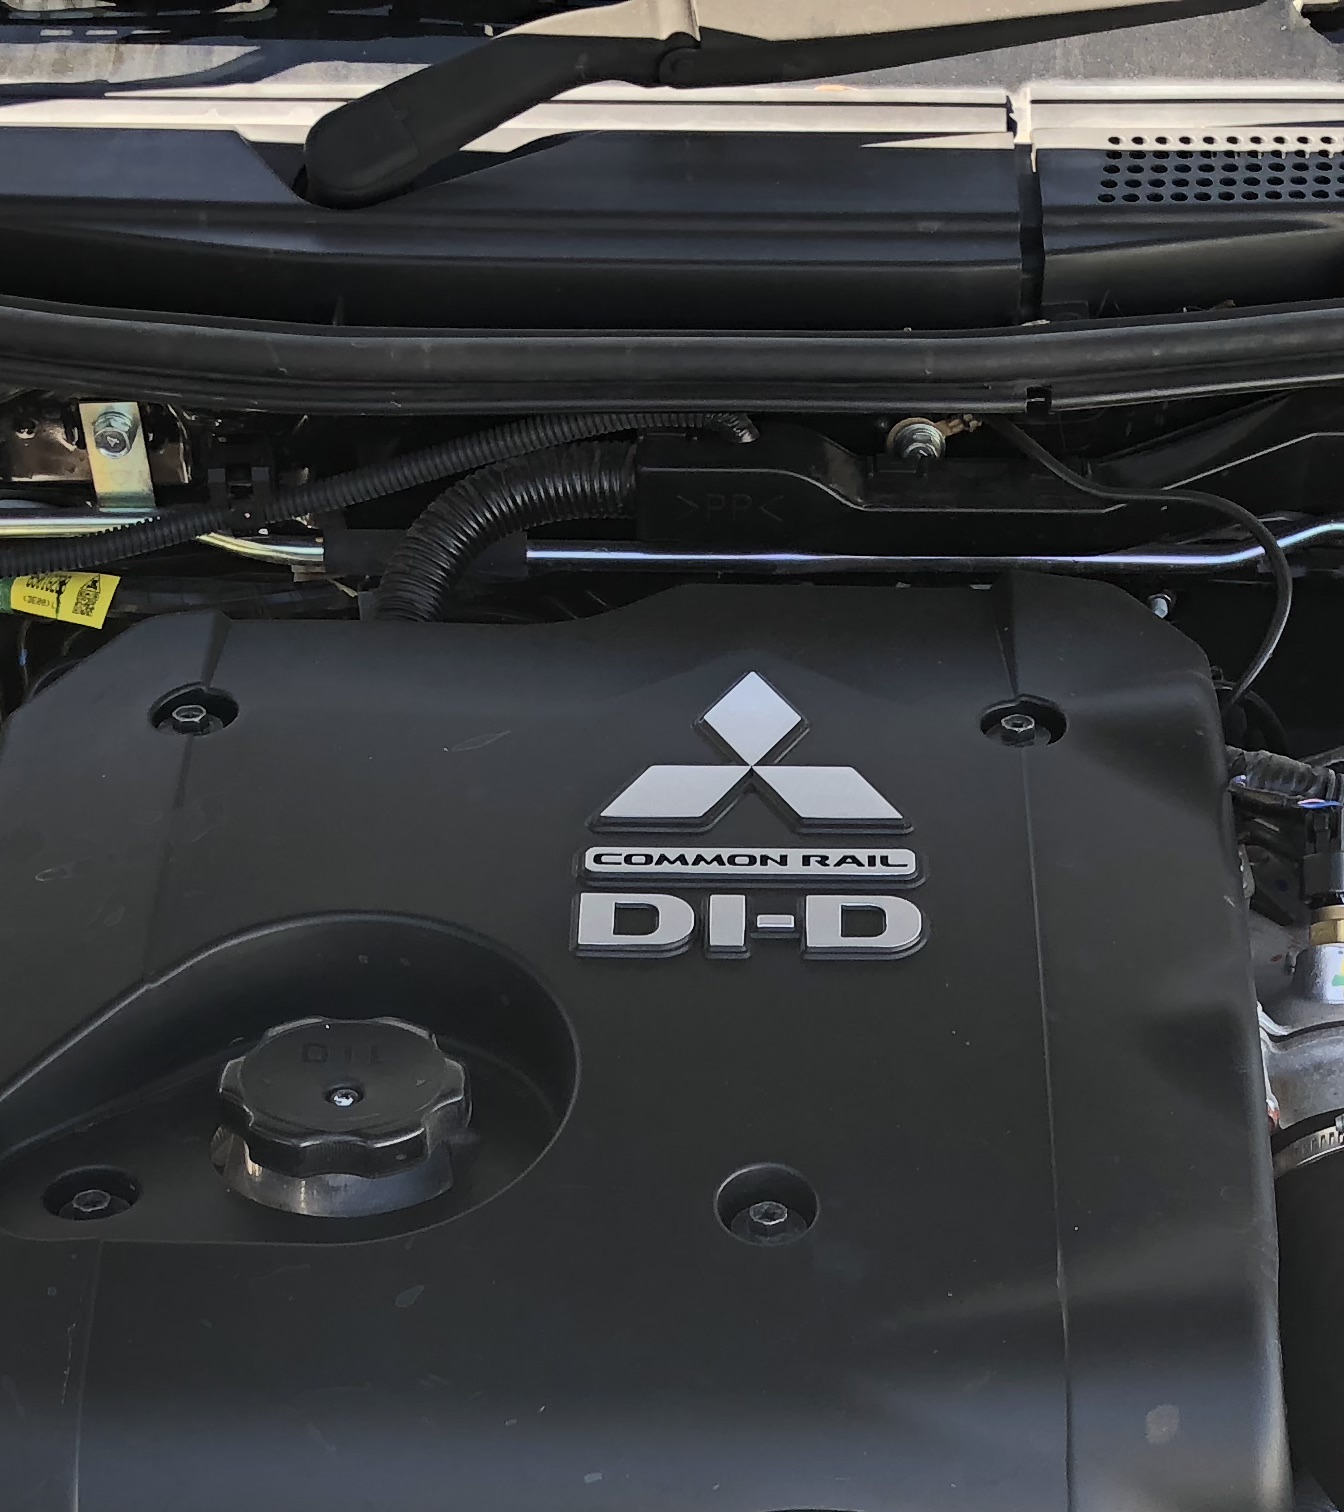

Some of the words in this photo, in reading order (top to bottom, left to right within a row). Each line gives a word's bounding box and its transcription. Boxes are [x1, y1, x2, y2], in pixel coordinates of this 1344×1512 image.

[592, 852, 788, 869] COMMON
[801, 853, 908, 869] RAIL
[577, 892, 923, 948] DI-D
